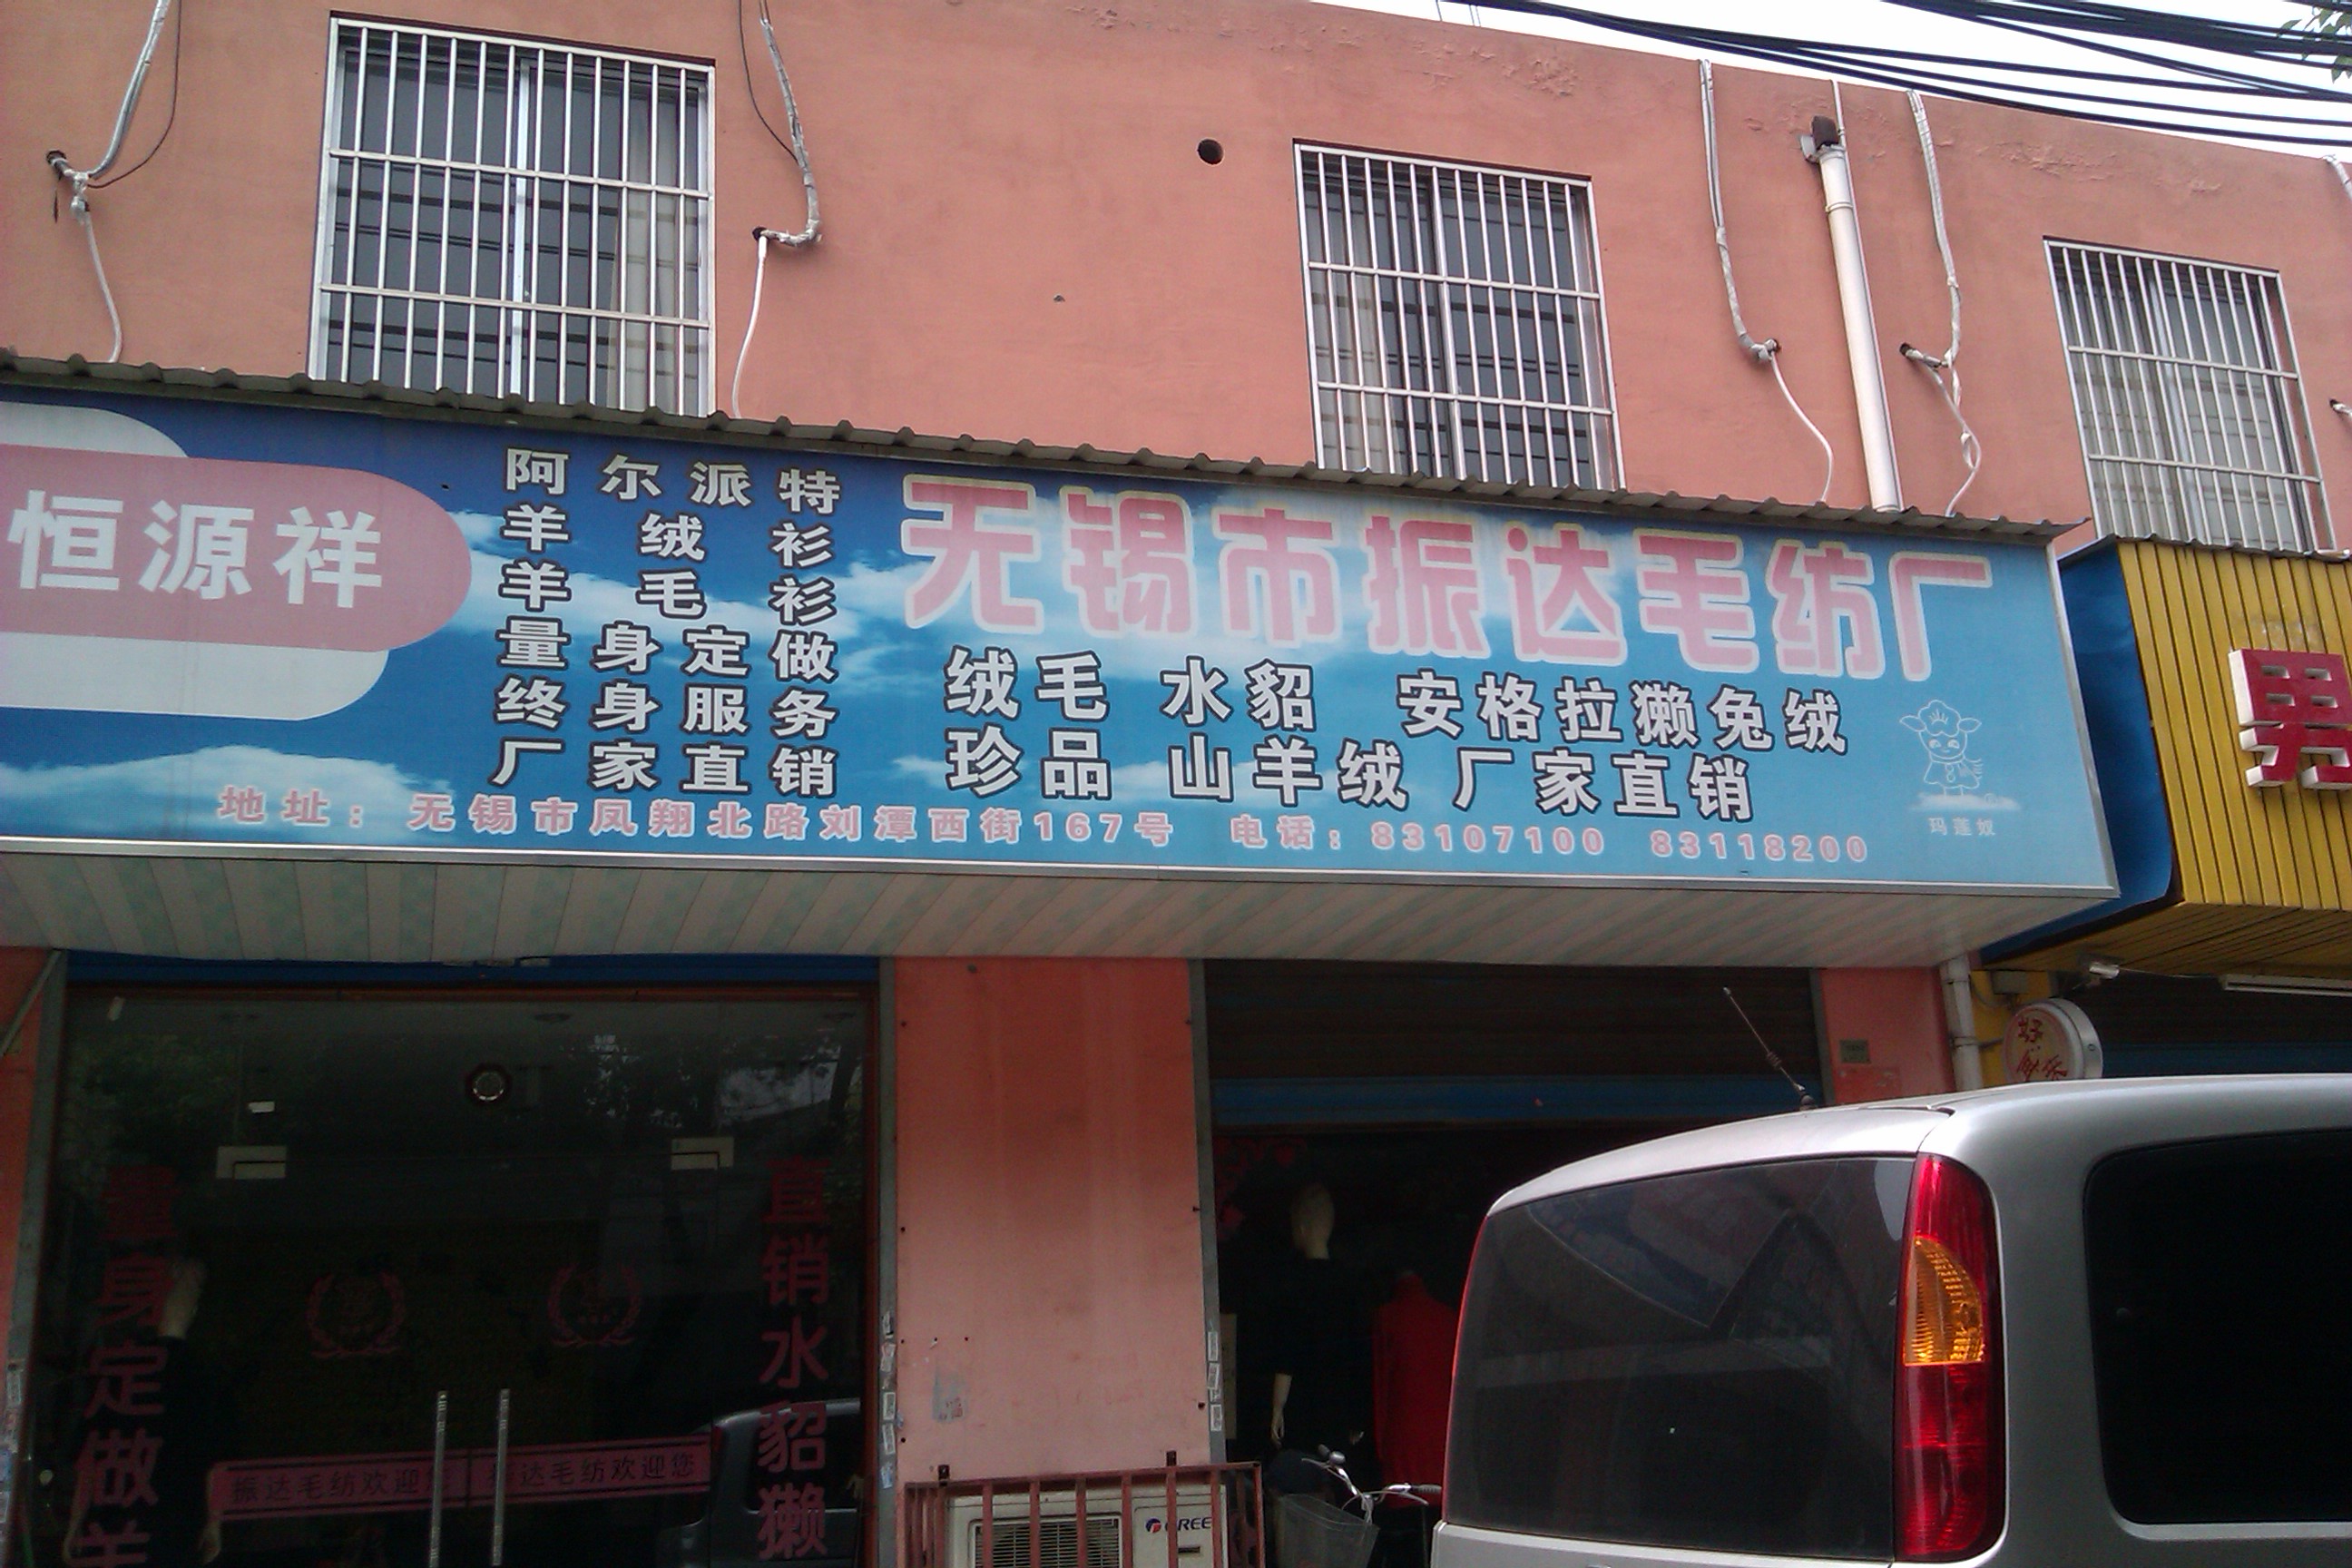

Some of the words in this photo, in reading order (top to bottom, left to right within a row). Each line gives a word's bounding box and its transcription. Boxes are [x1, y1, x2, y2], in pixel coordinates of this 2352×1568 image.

[505, 446, 842, 517] 阿尔派特
[7, 488, 386, 609] 恒源祥
[501, 504, 837, 570] 羊绒衫
[500, 559, 838, 626] 羊毛衫
[900, 473, 1994, 682] 无锡市振达毛纺厂
[496, 618, 838, 683] 量身定做
[494, 677, 838, 740] 终身服务
[1397, 669, 1847, 757] 安格拉獭兔绒
[2229, 647, 2352, 791] 男
[491, 738, 838, 799] 厂家直销
[1453, 747, 1755, 823] 厂家直销
[1649, 829, 1868, 863] 83118200
[757, 1154, 830, 1560] 直销水貂獭
[1165, 1516, 1212, 1532] REE
